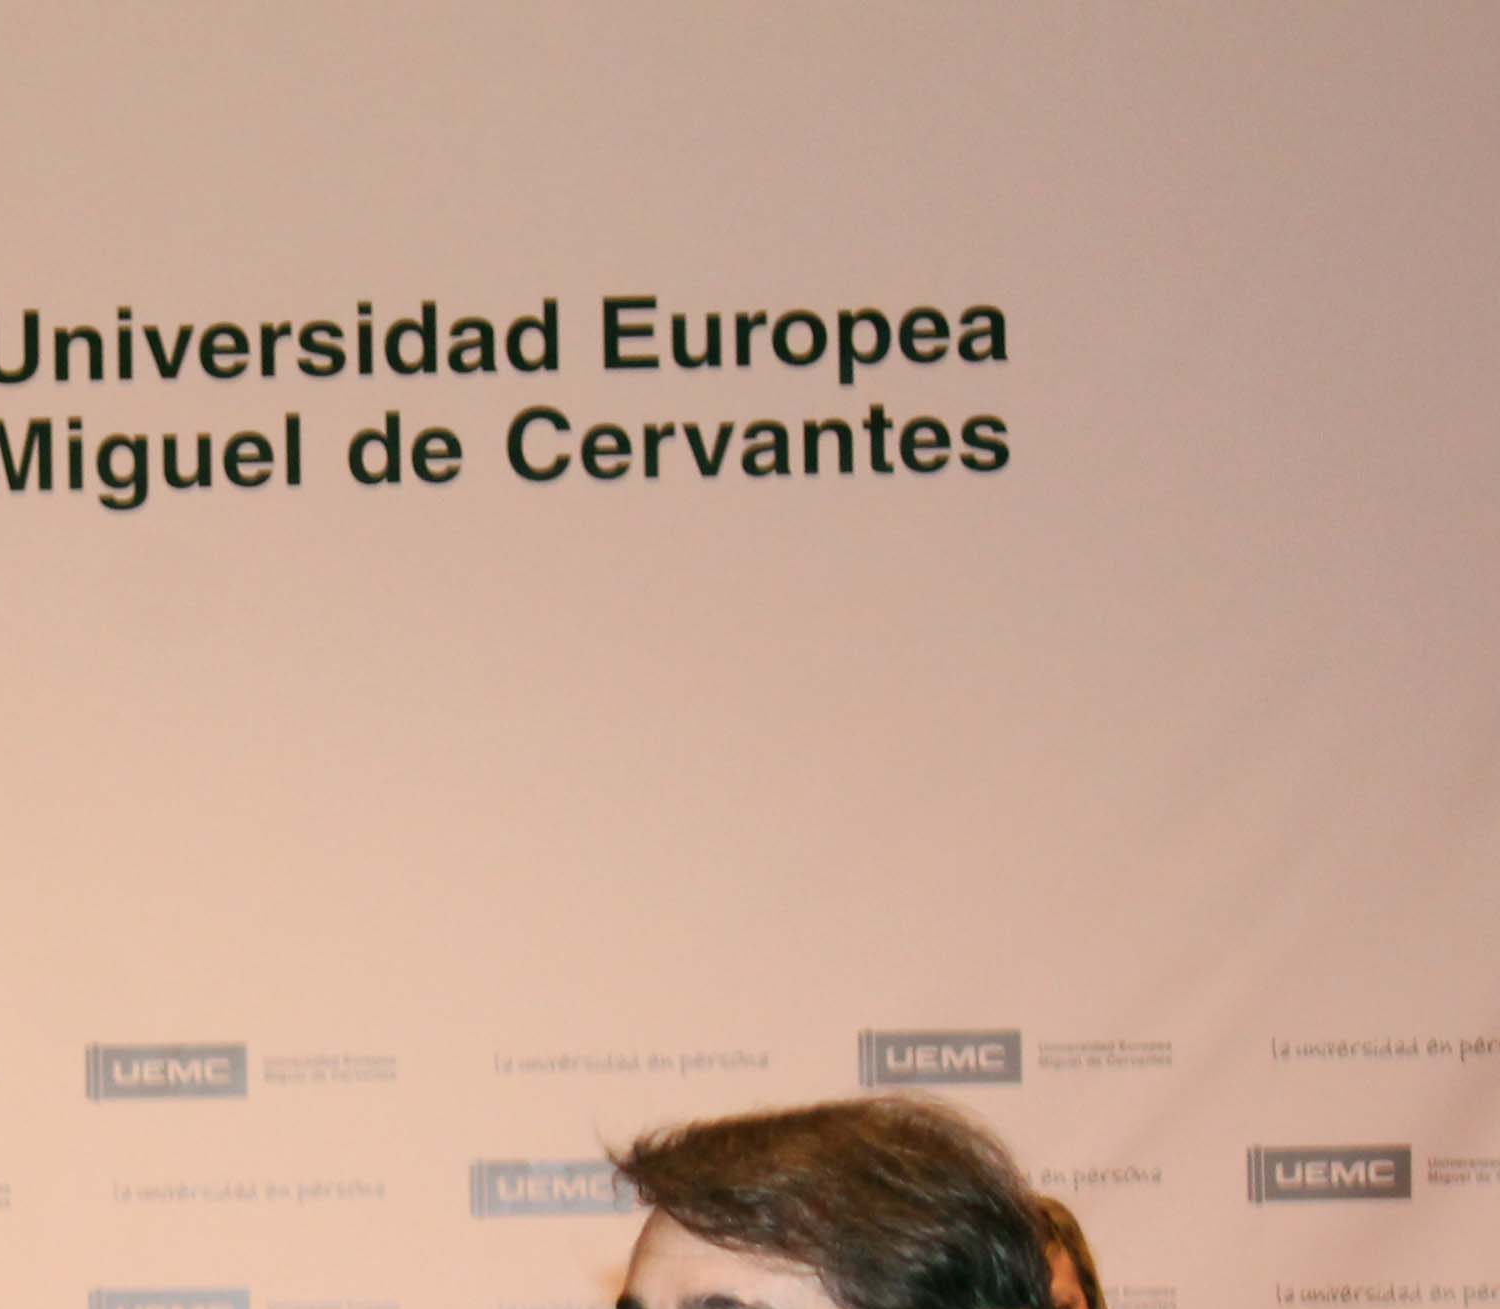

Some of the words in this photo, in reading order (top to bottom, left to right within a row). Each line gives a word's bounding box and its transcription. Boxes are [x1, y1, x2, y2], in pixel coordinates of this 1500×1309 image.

[601, 294, 1008, 386] Europea
[347, 410, 463, 486] de
[506, 402, 1010, 482] Cervantes
[886, 1044, 1004, 1072] UEMC
[1272, 1036, 1290, 1061] la
[1296, 1036, 1420, 1058] universidad
[1426, 1037, 1452, 1057] en
[112, 1058, 229, 1085] UEMC
[1274, 1160, 1393, 1189] UEMC
[1276, 1283, 1295, 1306] la
[1300, 1283, 1423, 1305] universidad
[1430, 1284, 1457, 1303] en
